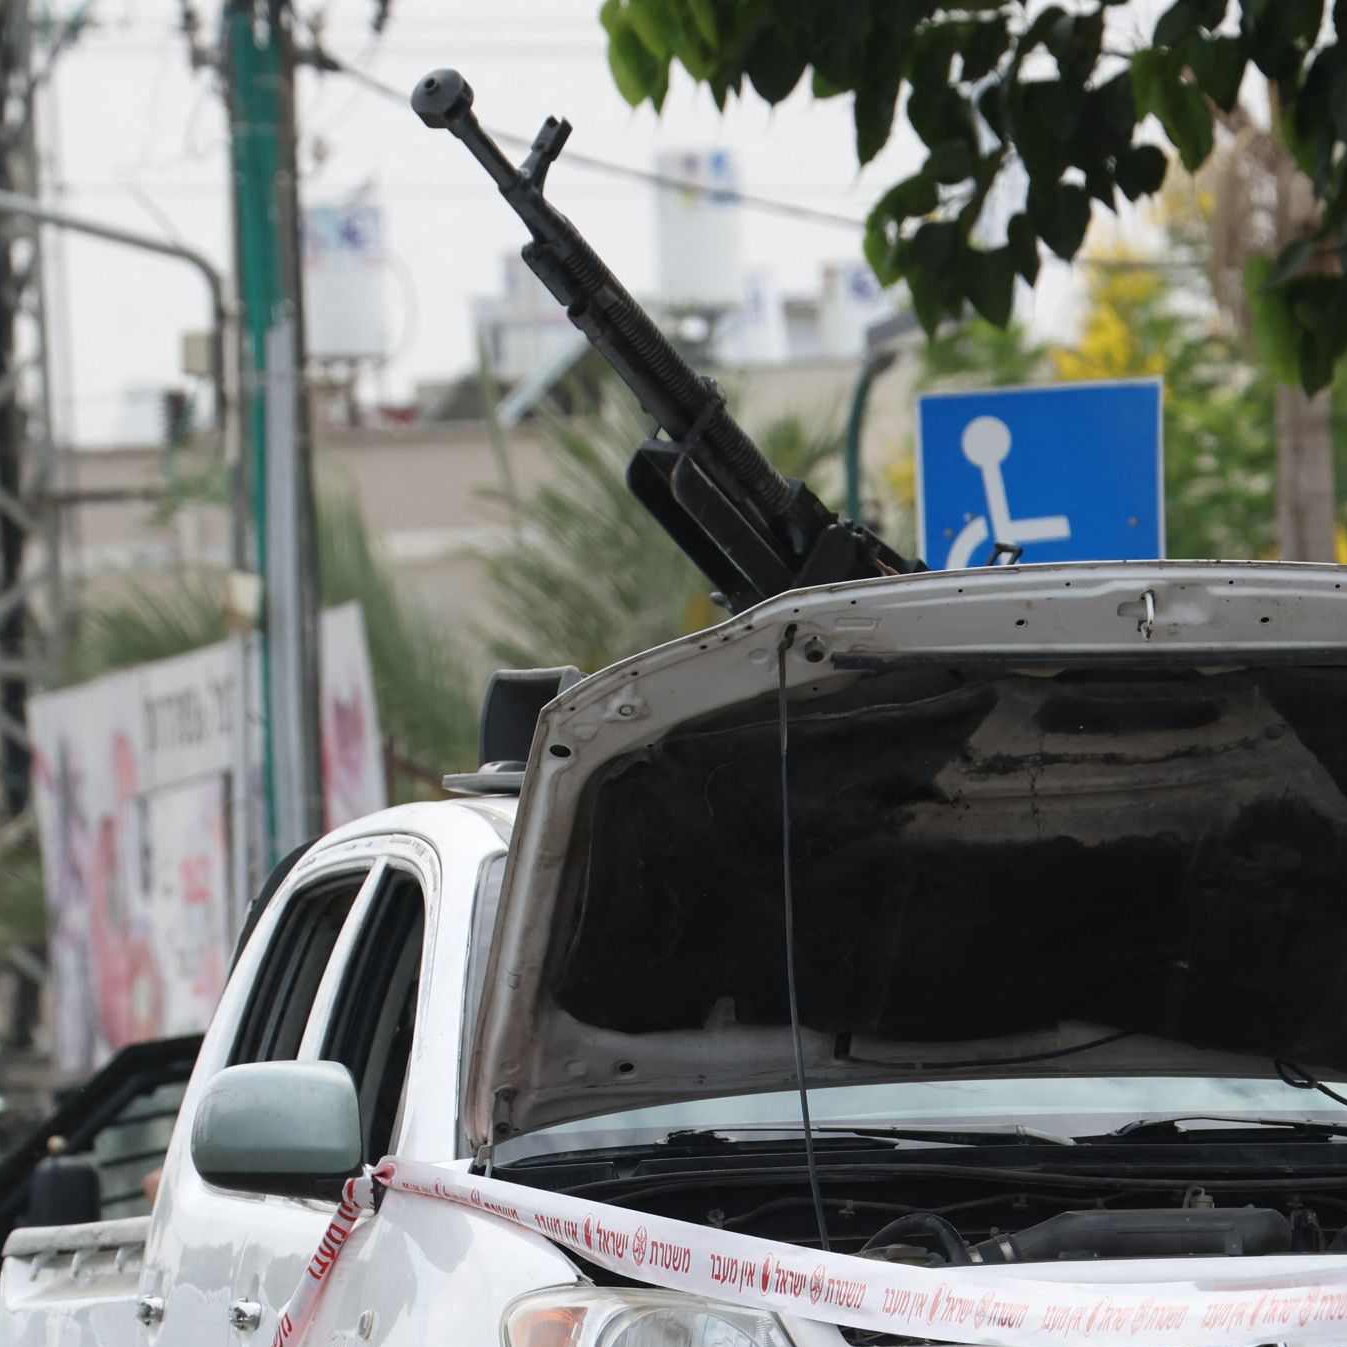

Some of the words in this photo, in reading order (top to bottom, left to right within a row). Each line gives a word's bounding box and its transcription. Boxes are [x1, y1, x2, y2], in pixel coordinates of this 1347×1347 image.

[306, 1222, 351, 1281] מעבר
[596, 1220, 630, 1259] ישראל
[649, 1240, 692, 1273] משטרת
[710, 1253, 739, 1285] מעבר
[739, 1261, 756, 1293] אין
[775, 1259, 806, 1298] ישראל
[824, 1277, 867, 1309] משטרת
[882, 1287, 911, 1318] מעבר
[907, 1292, 928, 1325] אין
[941, 1289, 975, 1324] ישראל
[987, 1301, 1029, 1329] משטרת
